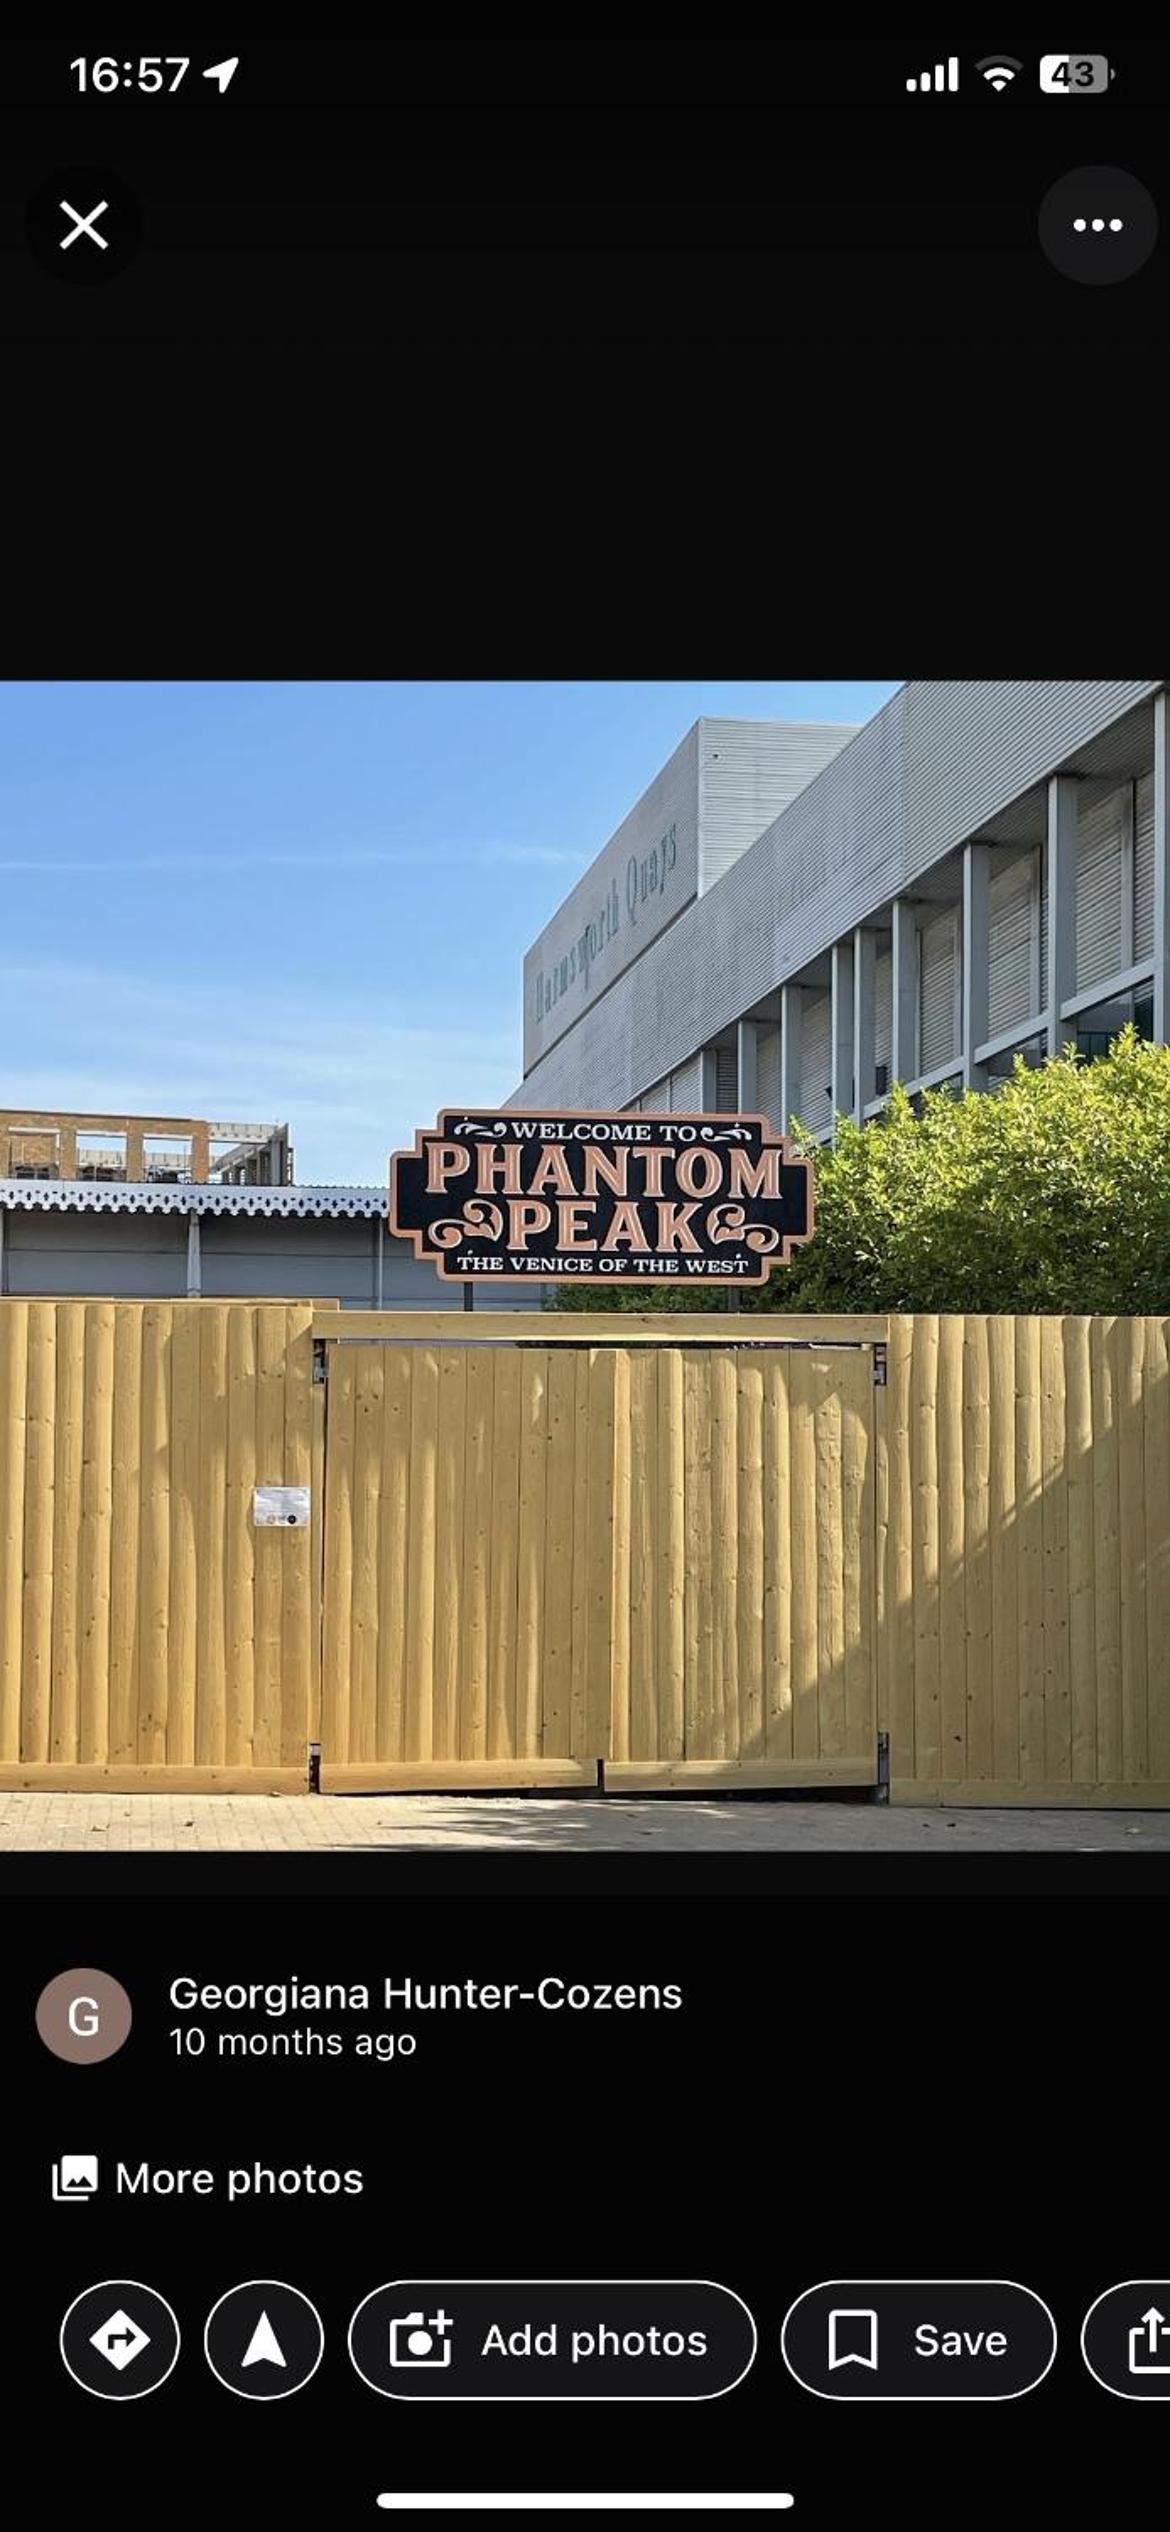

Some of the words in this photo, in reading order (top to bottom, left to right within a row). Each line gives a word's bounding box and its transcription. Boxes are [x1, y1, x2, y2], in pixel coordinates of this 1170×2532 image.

[626, 823, 677, 927] Quays
[510, 1120, 652, 1142] WELCOME
[659, 1125, 698, 1142] TO
[424, 1142, 783, 1199] PHANTOM
[506, 1200, 703, 1253] PEAK
[457, 1256, 504, 1272] THE
[508, 1256, 594, 1273] VENICE
[598, 1258, 627, 1273] OF
[633, 1258, 681, 1274] THE
[685, 1258, 749, 1275] WEST
